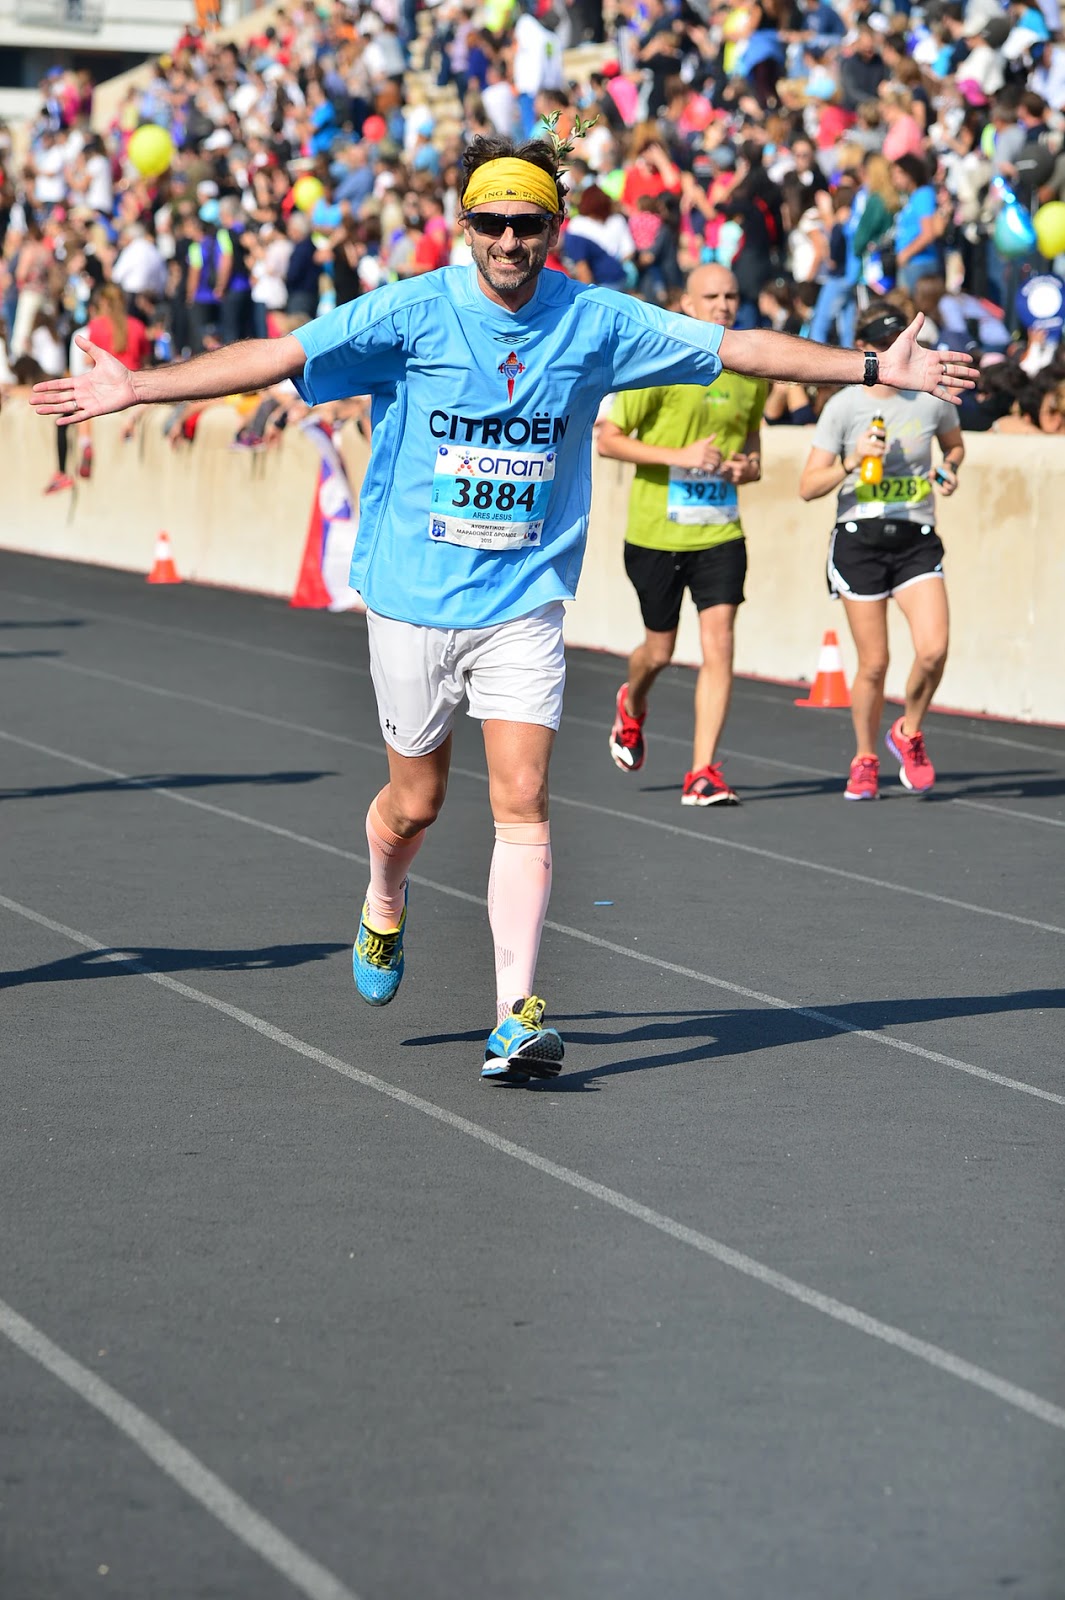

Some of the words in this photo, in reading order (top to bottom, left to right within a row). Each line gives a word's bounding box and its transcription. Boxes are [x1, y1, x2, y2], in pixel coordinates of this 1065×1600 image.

[484, 191, 503, 199] ING
[429, 409, 570, 445] CITROËN
[451, 478, 536, 512] 3884
[872, 479, 917, 497] 1928
[472, 511, 491, 520] ARES
[491, 512, 512, 521] JESUS
